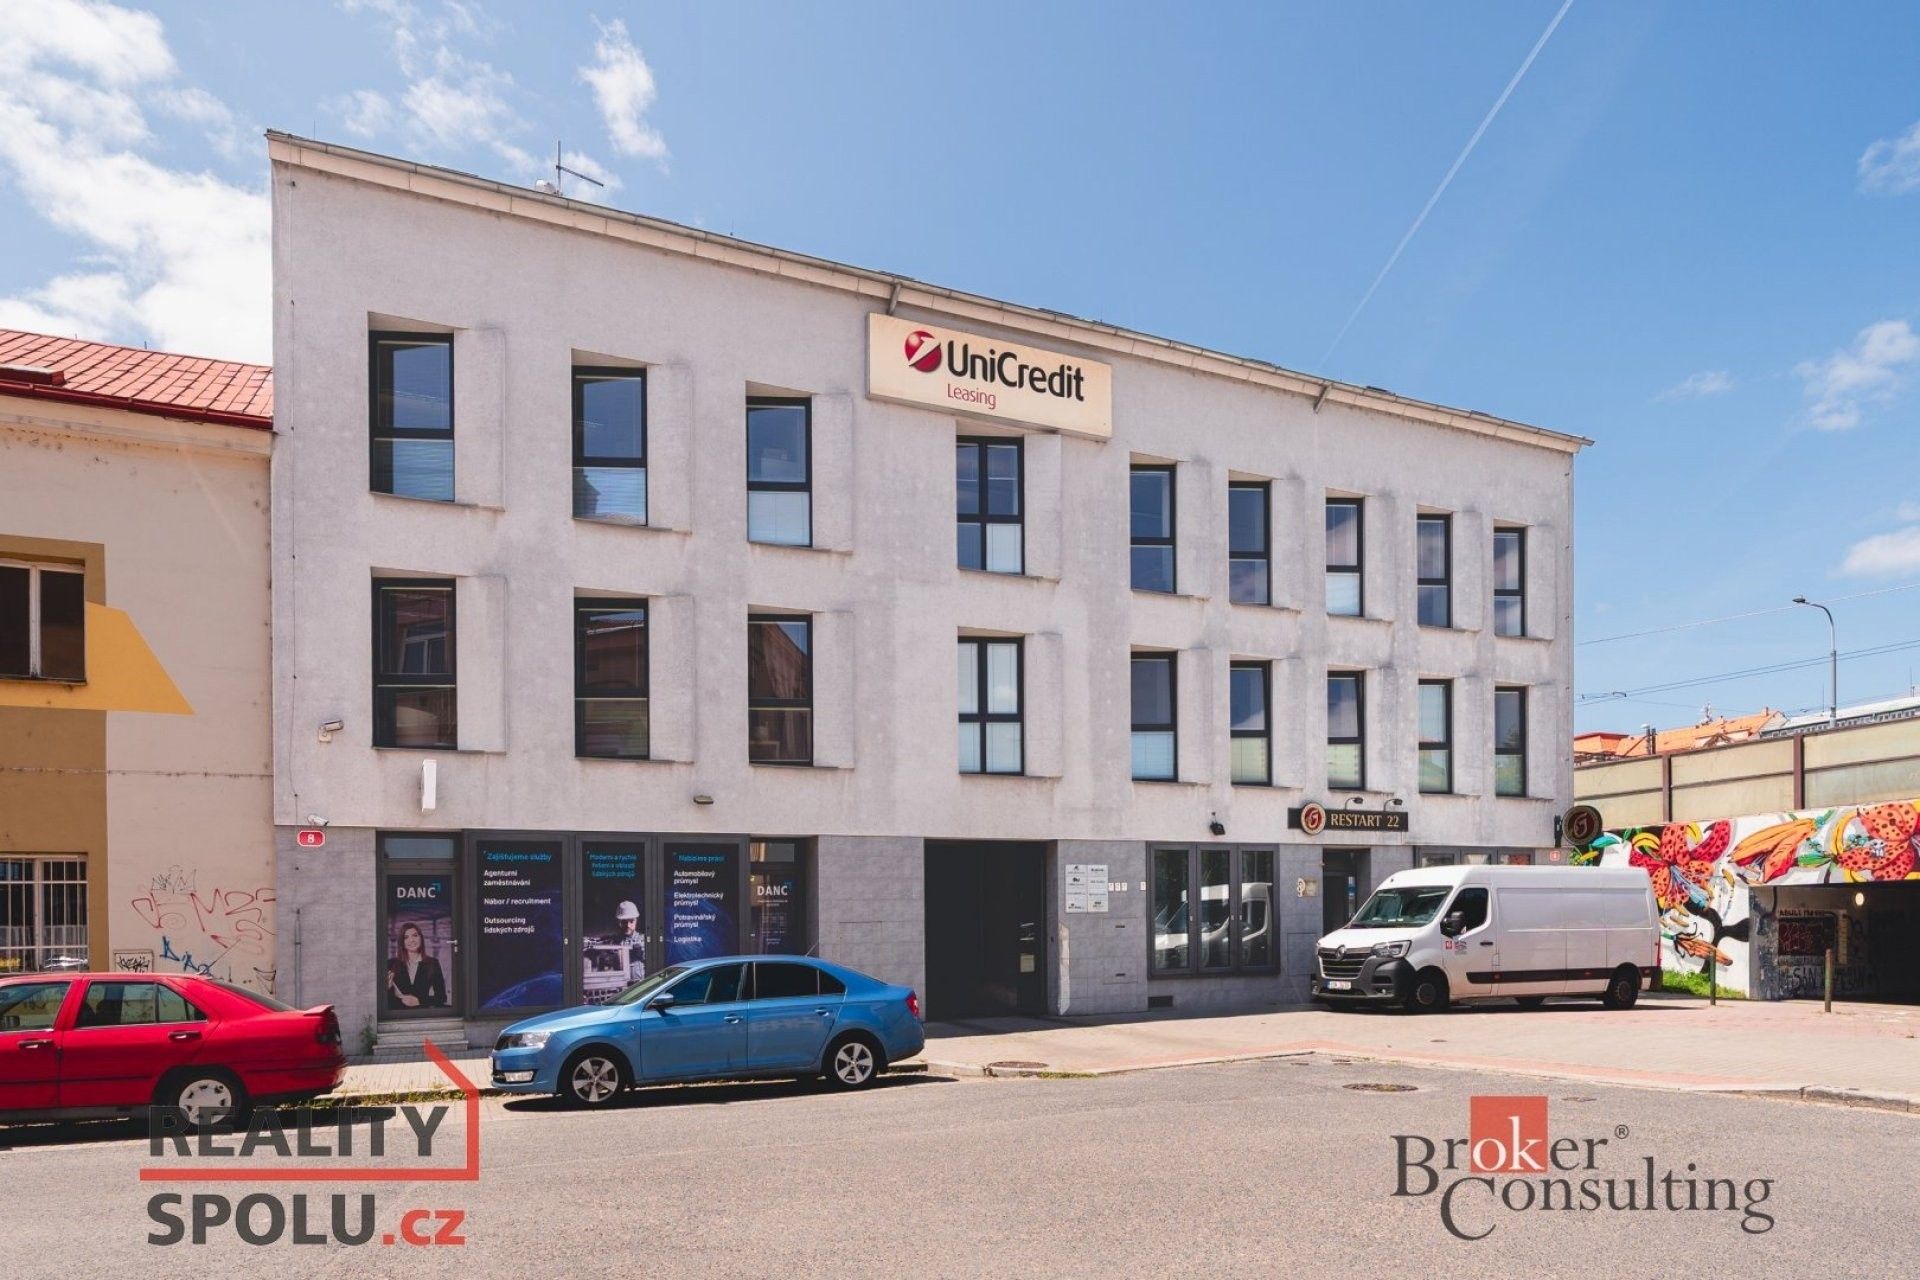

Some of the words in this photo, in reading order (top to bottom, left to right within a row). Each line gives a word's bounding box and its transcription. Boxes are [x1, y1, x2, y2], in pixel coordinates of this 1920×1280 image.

[947, 340, 1085, 402] UniCredit
[947, 383, 997, 410] Leasing
[1330, 813, 1383, 827] RESTART
[1387, 815, 1400, 828] 22
[307, 833, 315, 844] 8
[396, 886, 437, 899] DANC
[756, 885, 788, 896] DANC
[511, 897, 551, 905] recruitment
[484, 916, 526, 925] Outsourcing
